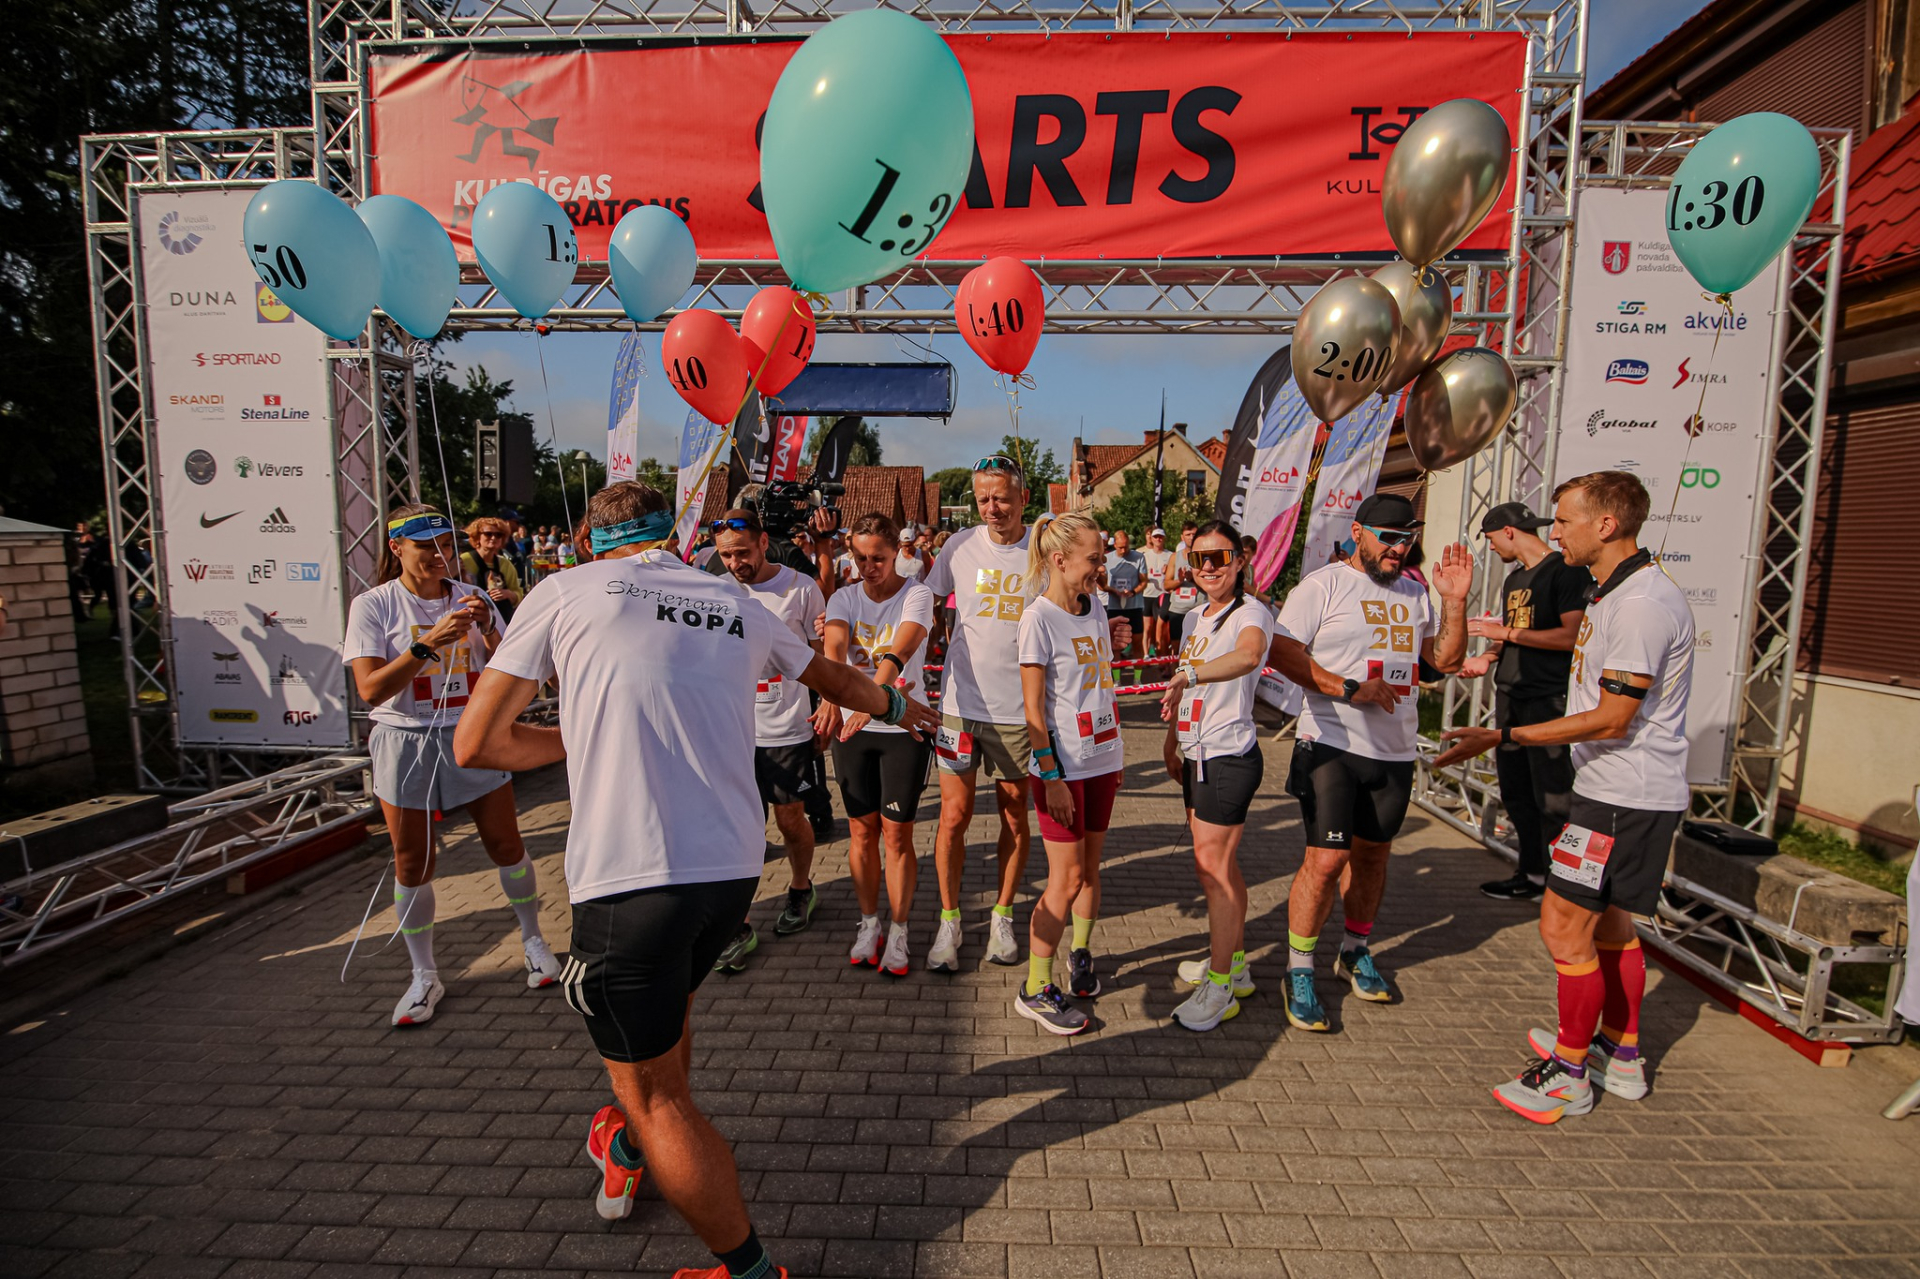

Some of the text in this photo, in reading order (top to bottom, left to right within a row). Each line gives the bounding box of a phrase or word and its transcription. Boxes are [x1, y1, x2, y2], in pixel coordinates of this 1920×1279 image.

[1326, 179, 1381, 195] KUL
[838, 158, 952, 256] 1:3
[1668, 175, 1765, 231] 1:30
[1637, 253, 1670, 261] novada
[252, 243, 308, 290] 50
[170, 291, 237, 306] DUNA
[968, 297, 1024, 337] 1:40
[1596, 321, 1667, 335] STIGA RM
[212, 352, 282, 366] SPORTLAND
[1313, 341, 1393, 383] 2:00
[1608, 362, 1647, 377] Baltais
[169, 394, 224, 405] SKANDI
[241, 407, 310, 420] Stena Line
[1601, 419, 1659, 429] global
[1706, 422, 1737, 432] KORP
[772, 416, 796, 481] TLAND
[257, 462, 304, 477] Vēvers
[1260, 466, 1290, 484] bta
[1324, 488, 1355, 510] bta
[259, 524, 296, 533] adidas
[252, 564, 272, 579] RE
[605, 580, 732, 615] Skrienam
[656, 604, 746, 640] KOPĀ
[1389, 669, 1408, 680] 174
